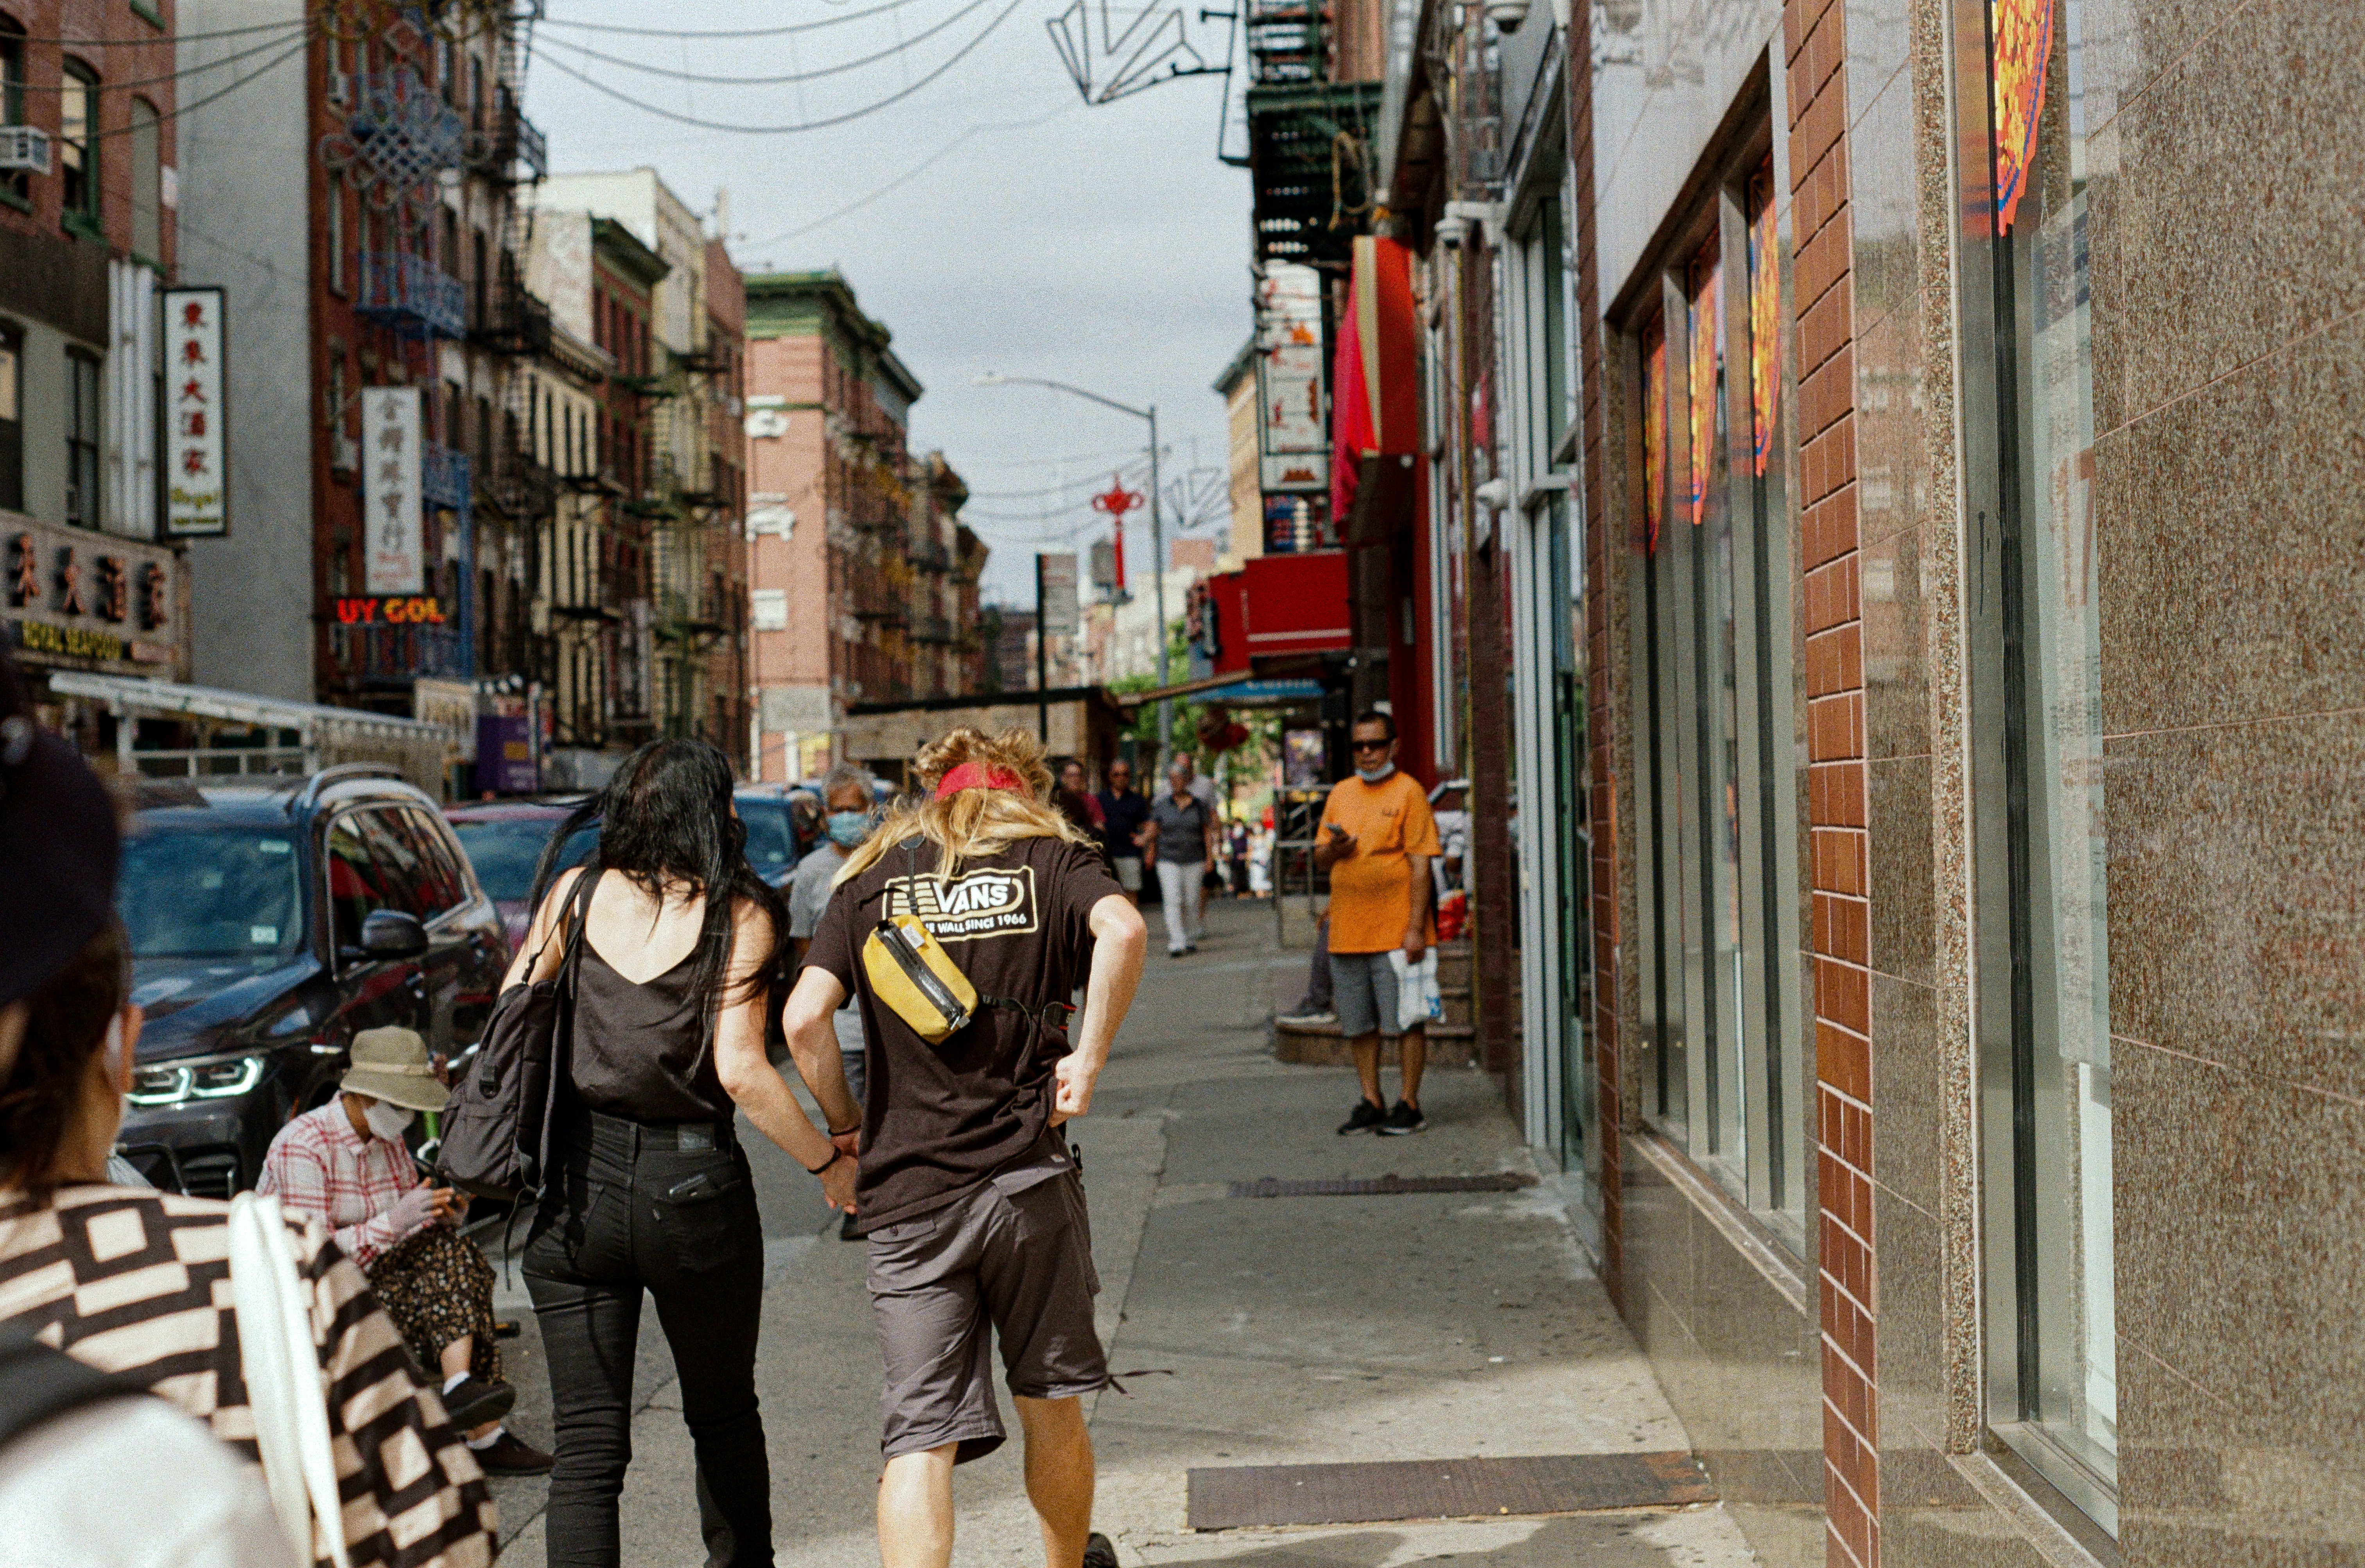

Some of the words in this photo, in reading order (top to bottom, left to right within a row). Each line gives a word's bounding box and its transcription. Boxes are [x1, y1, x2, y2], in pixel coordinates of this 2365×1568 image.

[933, 875, 1011, 914] VANS
[937, 921, 965, 934] WALL
[965, 917, 994, 930] SINCE
[997, 913, 1027, 926] 1966
